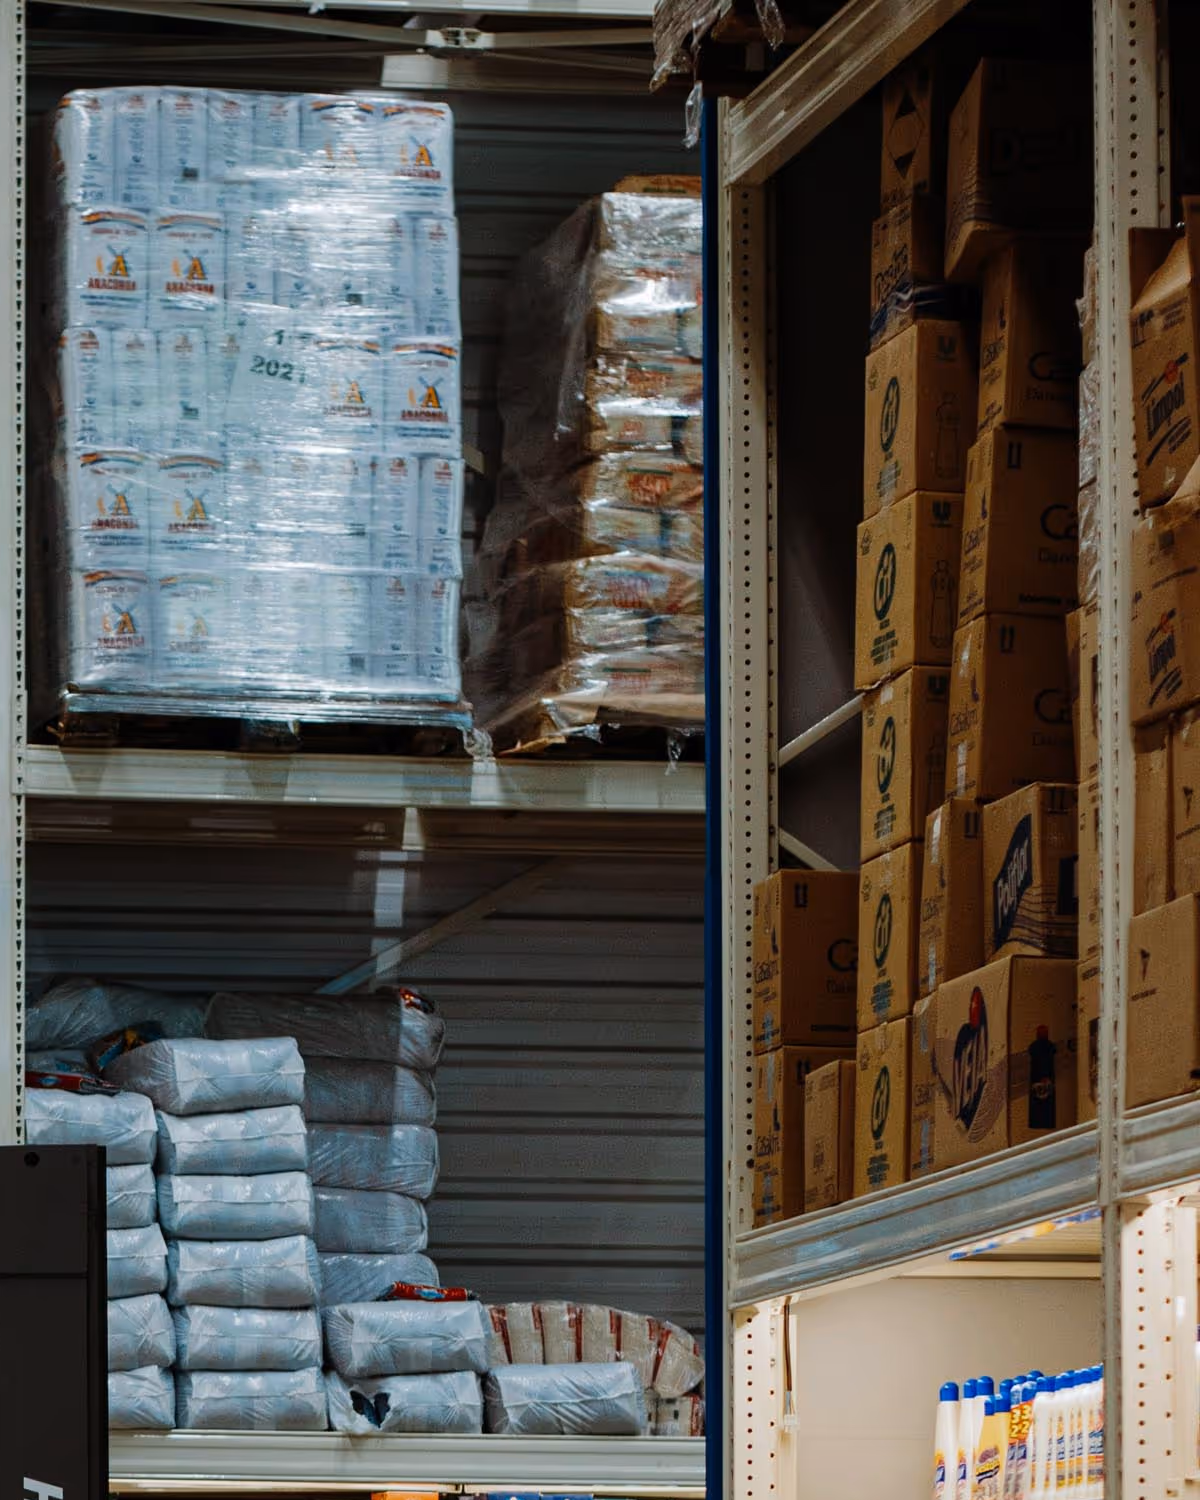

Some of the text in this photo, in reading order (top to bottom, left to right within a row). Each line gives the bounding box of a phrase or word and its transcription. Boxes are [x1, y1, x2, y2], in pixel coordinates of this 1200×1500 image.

[954, 1022, 987, 1118] VEJA
[1022, 1404, 1031, 1419] 3
[1022, 1421, 1030, 1434] 2
